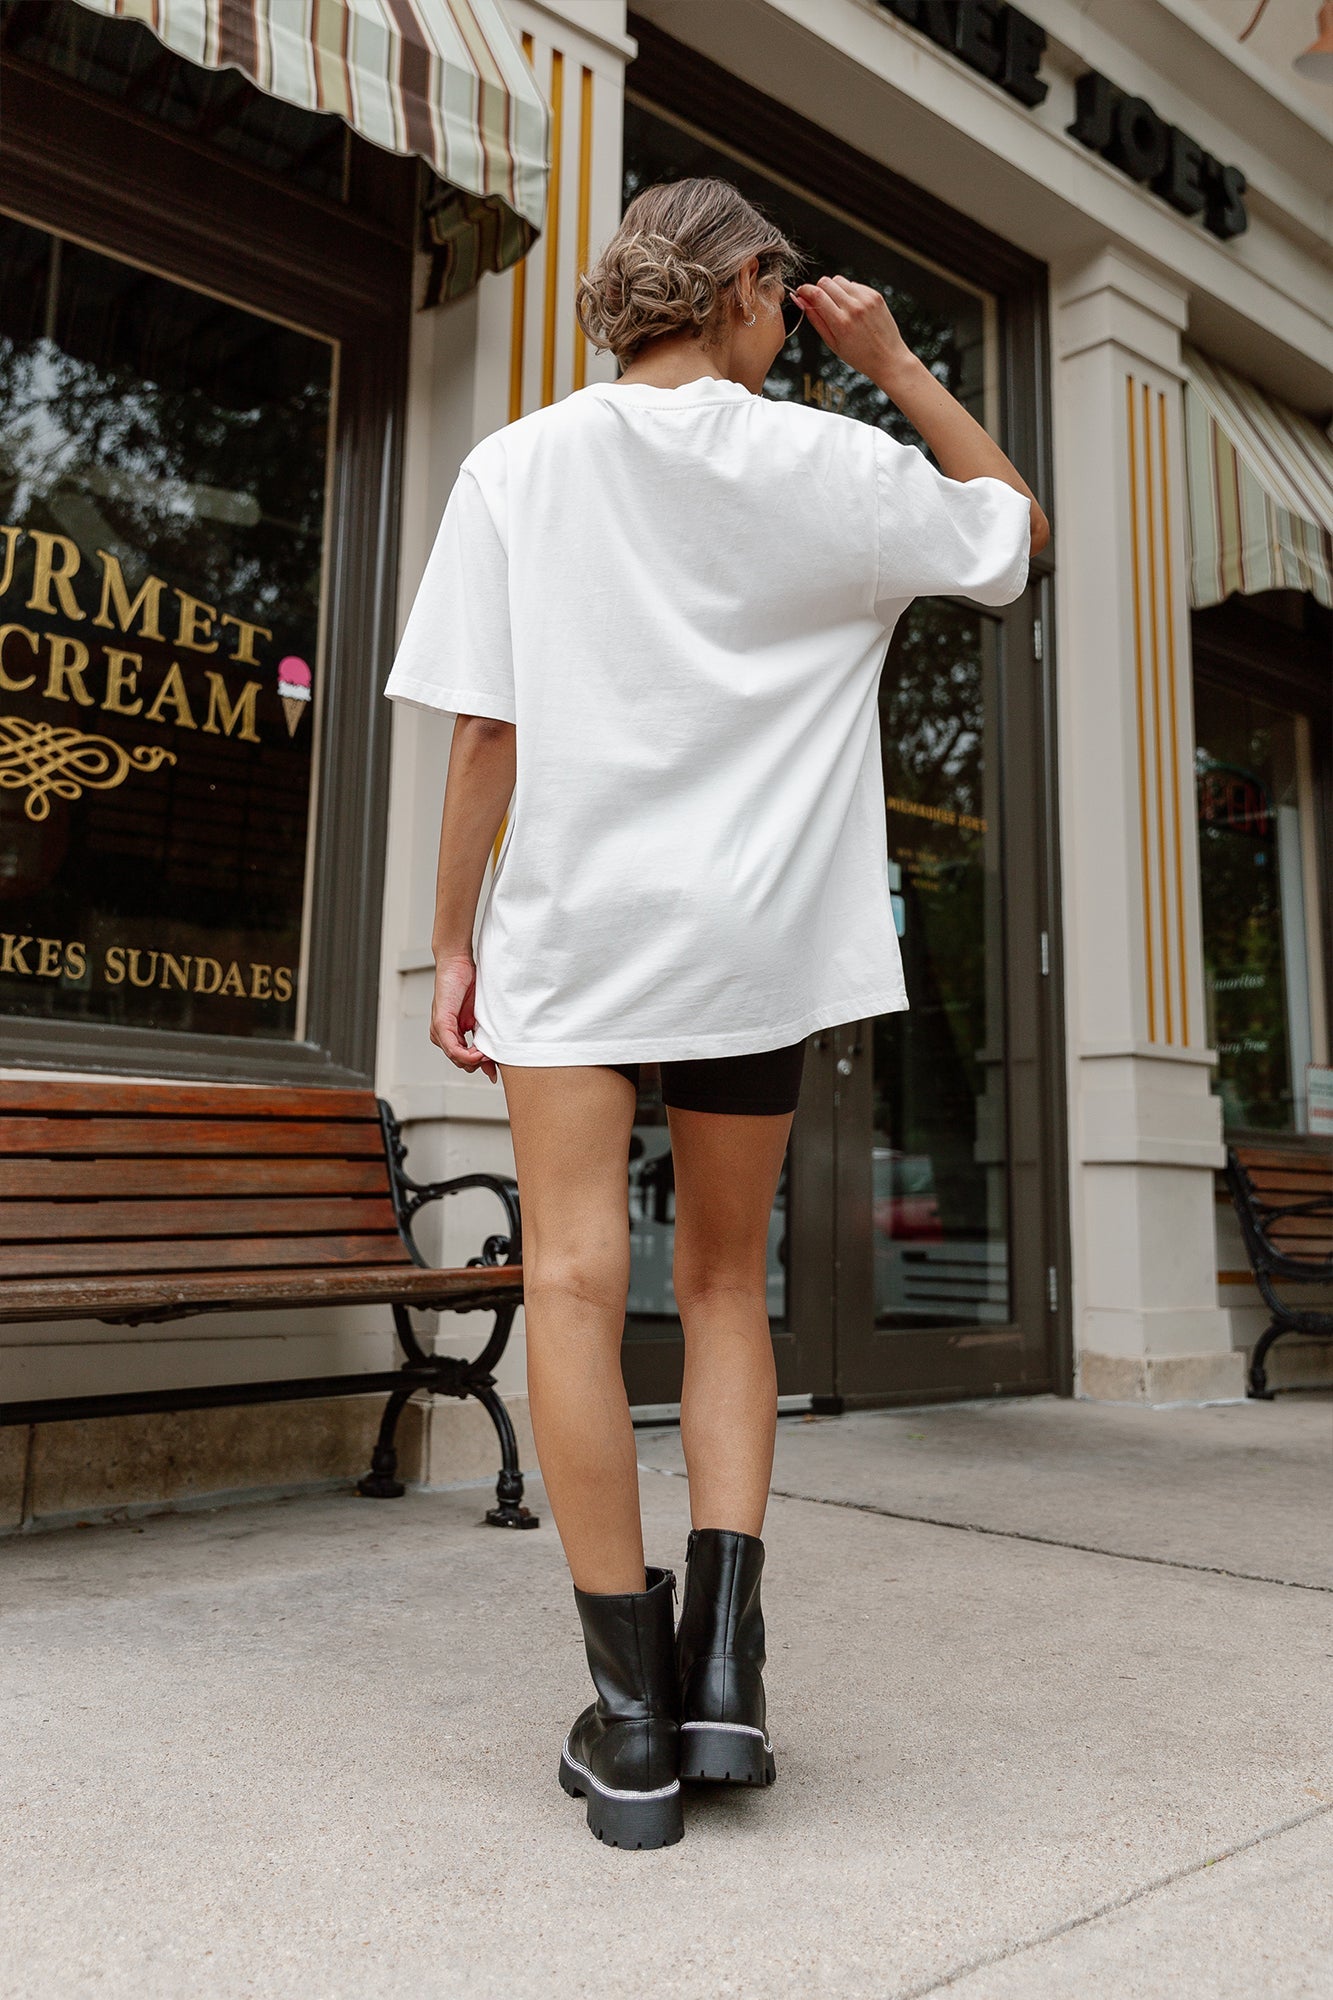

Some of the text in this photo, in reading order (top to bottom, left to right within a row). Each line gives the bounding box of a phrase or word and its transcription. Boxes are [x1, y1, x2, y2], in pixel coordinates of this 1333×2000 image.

[1065, 71, 1247, 240] JOE'S
[0, 622, 263, 744] CREAM
[0, 933, 293, 1002] KES SUNDAES
